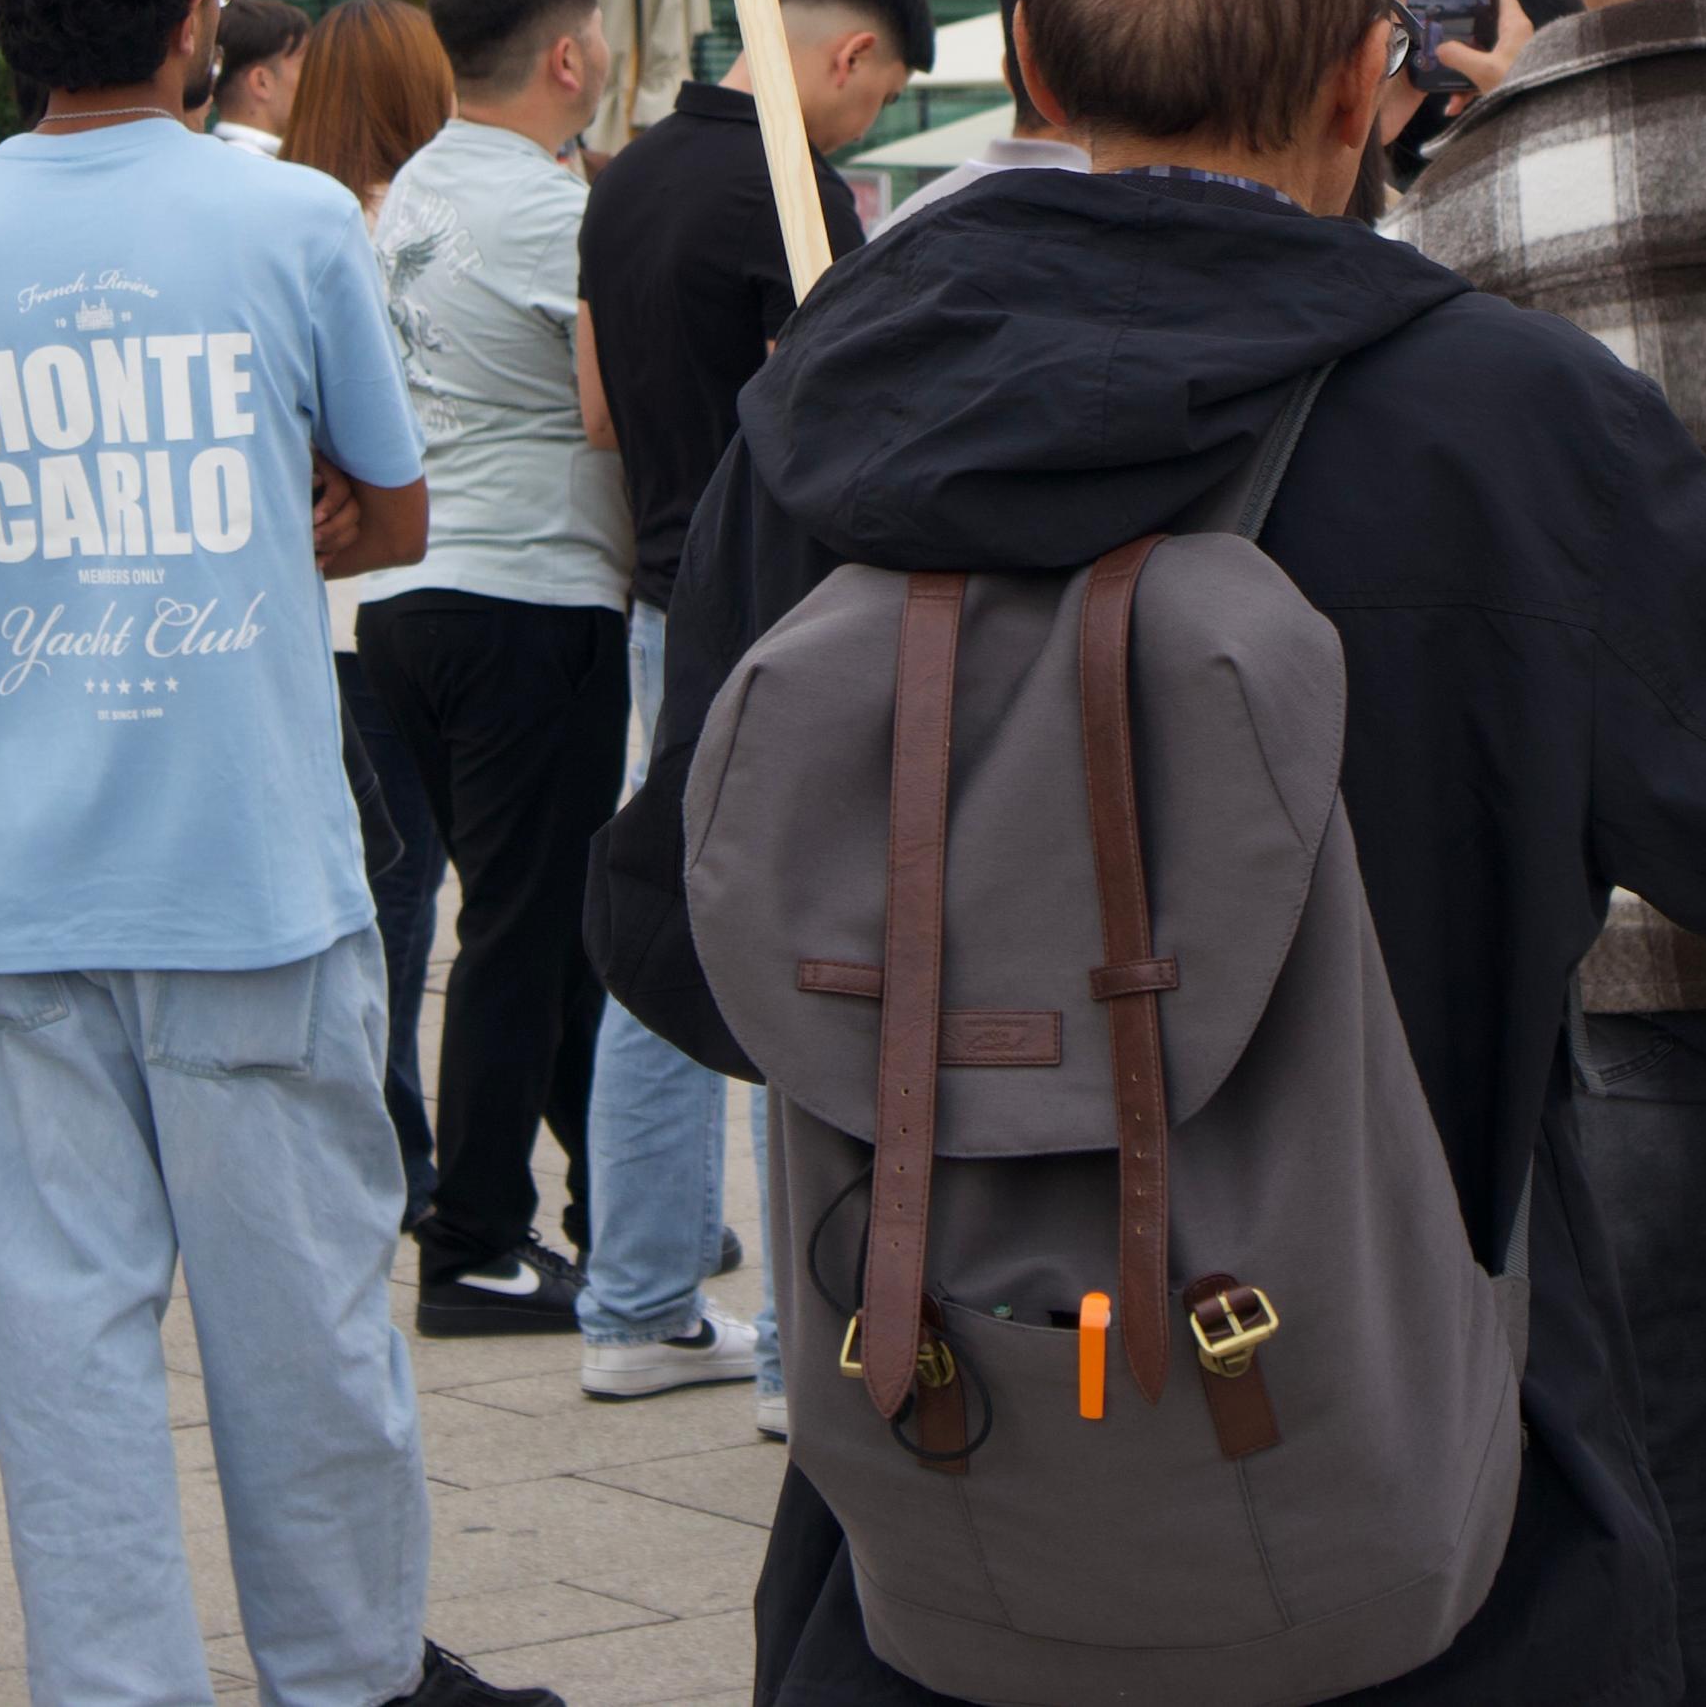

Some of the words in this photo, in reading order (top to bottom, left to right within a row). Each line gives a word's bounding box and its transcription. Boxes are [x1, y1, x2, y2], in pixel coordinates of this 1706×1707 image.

[77, 569, 130, 585] MEMBERS
[132, 568, 166, 584] ONLY
[145, 590, 267, 658] Club
